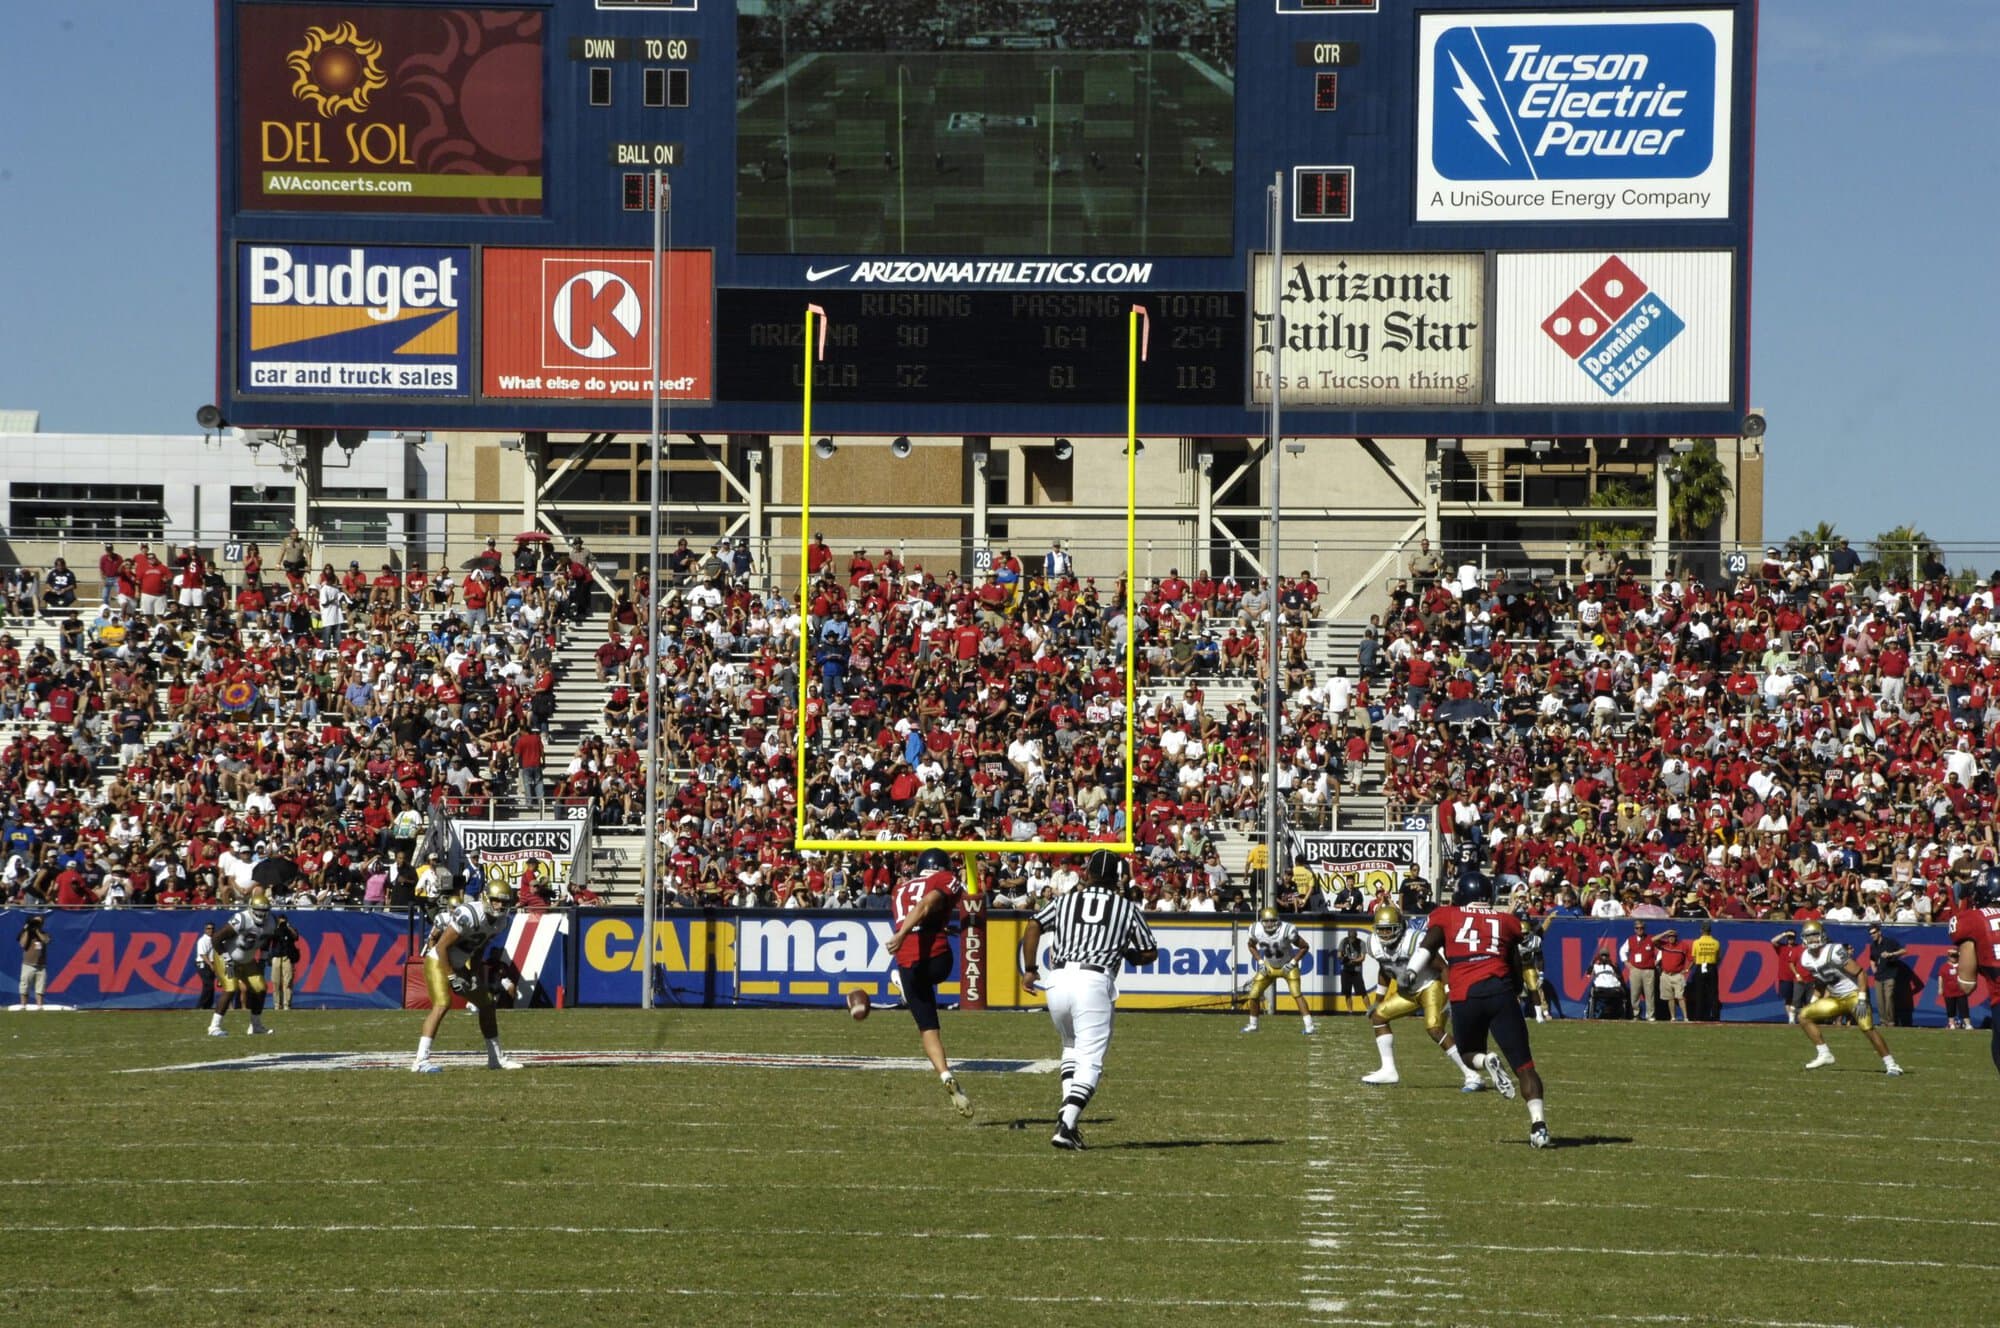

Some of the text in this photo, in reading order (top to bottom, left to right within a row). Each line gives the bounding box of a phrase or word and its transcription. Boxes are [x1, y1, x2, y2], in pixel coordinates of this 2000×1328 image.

[585, 39, 615, 59] DWN
[646, 39, 688, 60] TO GO
[1314, 44, 1340, 64] QTR
[1504, 45, 1649, 81] Tucson
[1518, 83, 1688, 118] Electric
[262, 121, 415, 165] DEL SOL
[1534, 121, 1686, 156] Power
[618, 145, 674, 165] BALL ON
[269, 176, 413, 192] AVAconcerts.com
[1431, 188, 1711, 209] A UniSource Energy Company
[251, 247, 458, 321] Budget
[850, 261, 1153, 285] ARIZONAATHLETICS.COM
[1280, 260, 1453, 303] Arizona
[861, 294, 1236, 319] RUSHING PASSING TOTAL
[751, 322, 859, 348] ARIZNA
[1253, 310, 1478, 361] Daily Star
[1583, 303, 1661, 376] Domino's
[255, 366, 453, 386] car and truck sales
[1600, 345, 1651, 391] Pizza
[499, 375, 542, 390] What
[546, 377, 580, 390] else
[585, 377, 606, 391] do
[610, 379, 640, 394] you
[1297, 375, 1310, 390] a
[1318, 370, 1400, 390] Tucson
[1409, 370, 1475, 394] thing.
[977, 551, 990, 567] 28
[1730, 556, 1745, 572] 29
[567, 807, 588, 820] 28
[1405, 818, 1426, 830] 29
[465, 831, 570, 850] BRUEGGER'S
[1306, 842, 1413, 862] BRUEGGER'S
[1328, 863, 1358, 872] BAKED
[1081, 891, 1110, 924] U
[1455, 916, 1500, 955] 41
[962, 899, 983, 1001] WILDCATS
